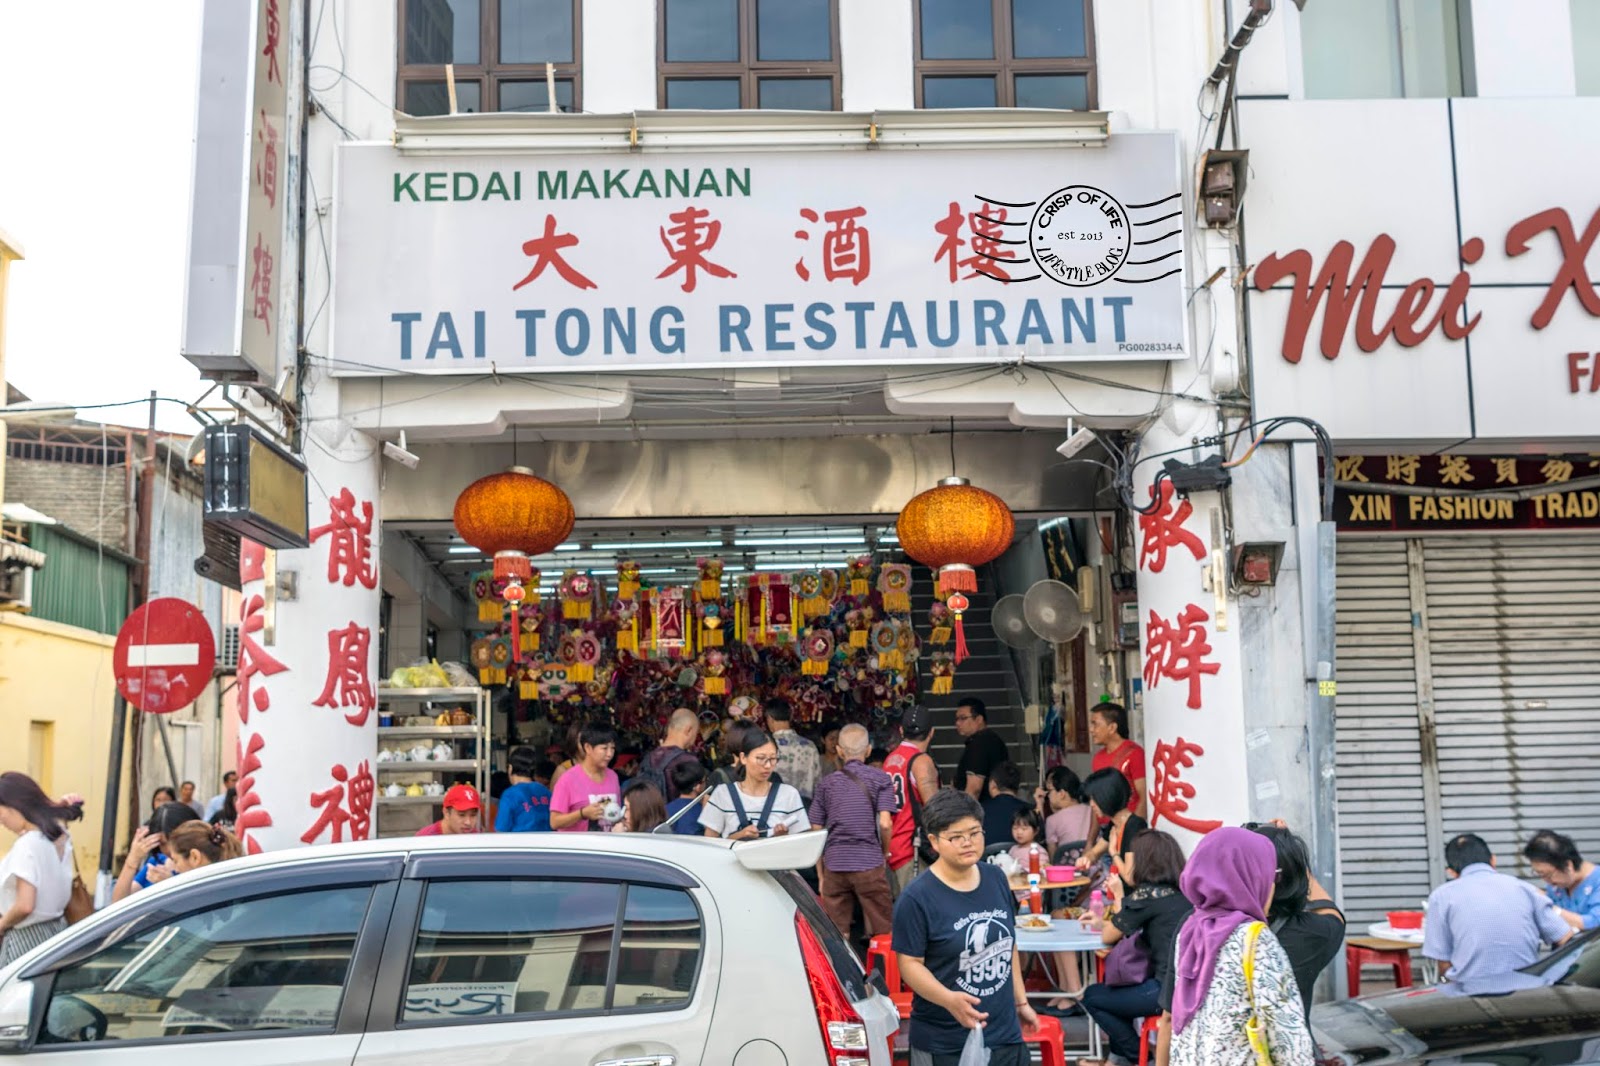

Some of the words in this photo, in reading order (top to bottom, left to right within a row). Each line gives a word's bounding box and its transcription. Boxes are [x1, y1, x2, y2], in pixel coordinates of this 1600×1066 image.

[394, 171, 521, 202] KEDAI
[538, 168, 751, 200] MAKANAN
[513, 201, 1017, 293] 大東酒樓
[1254, 233, 1483, 364] Mei
[391, 311, 485, 360] TAI
[515, 306, 685, 357] TONG
[719, 296, 1133, 353] RESTAURANT
[1118, 343, 1183, 352] PG0028334-A
[1349, 495, 1392, 521] XIN
[1409, 495, 1514, 520] FASHION
[1532, 491, 1600, 518] TRAD
[965, 951, 1007, 984] 1996
[980, 987, 995, 997] AND
